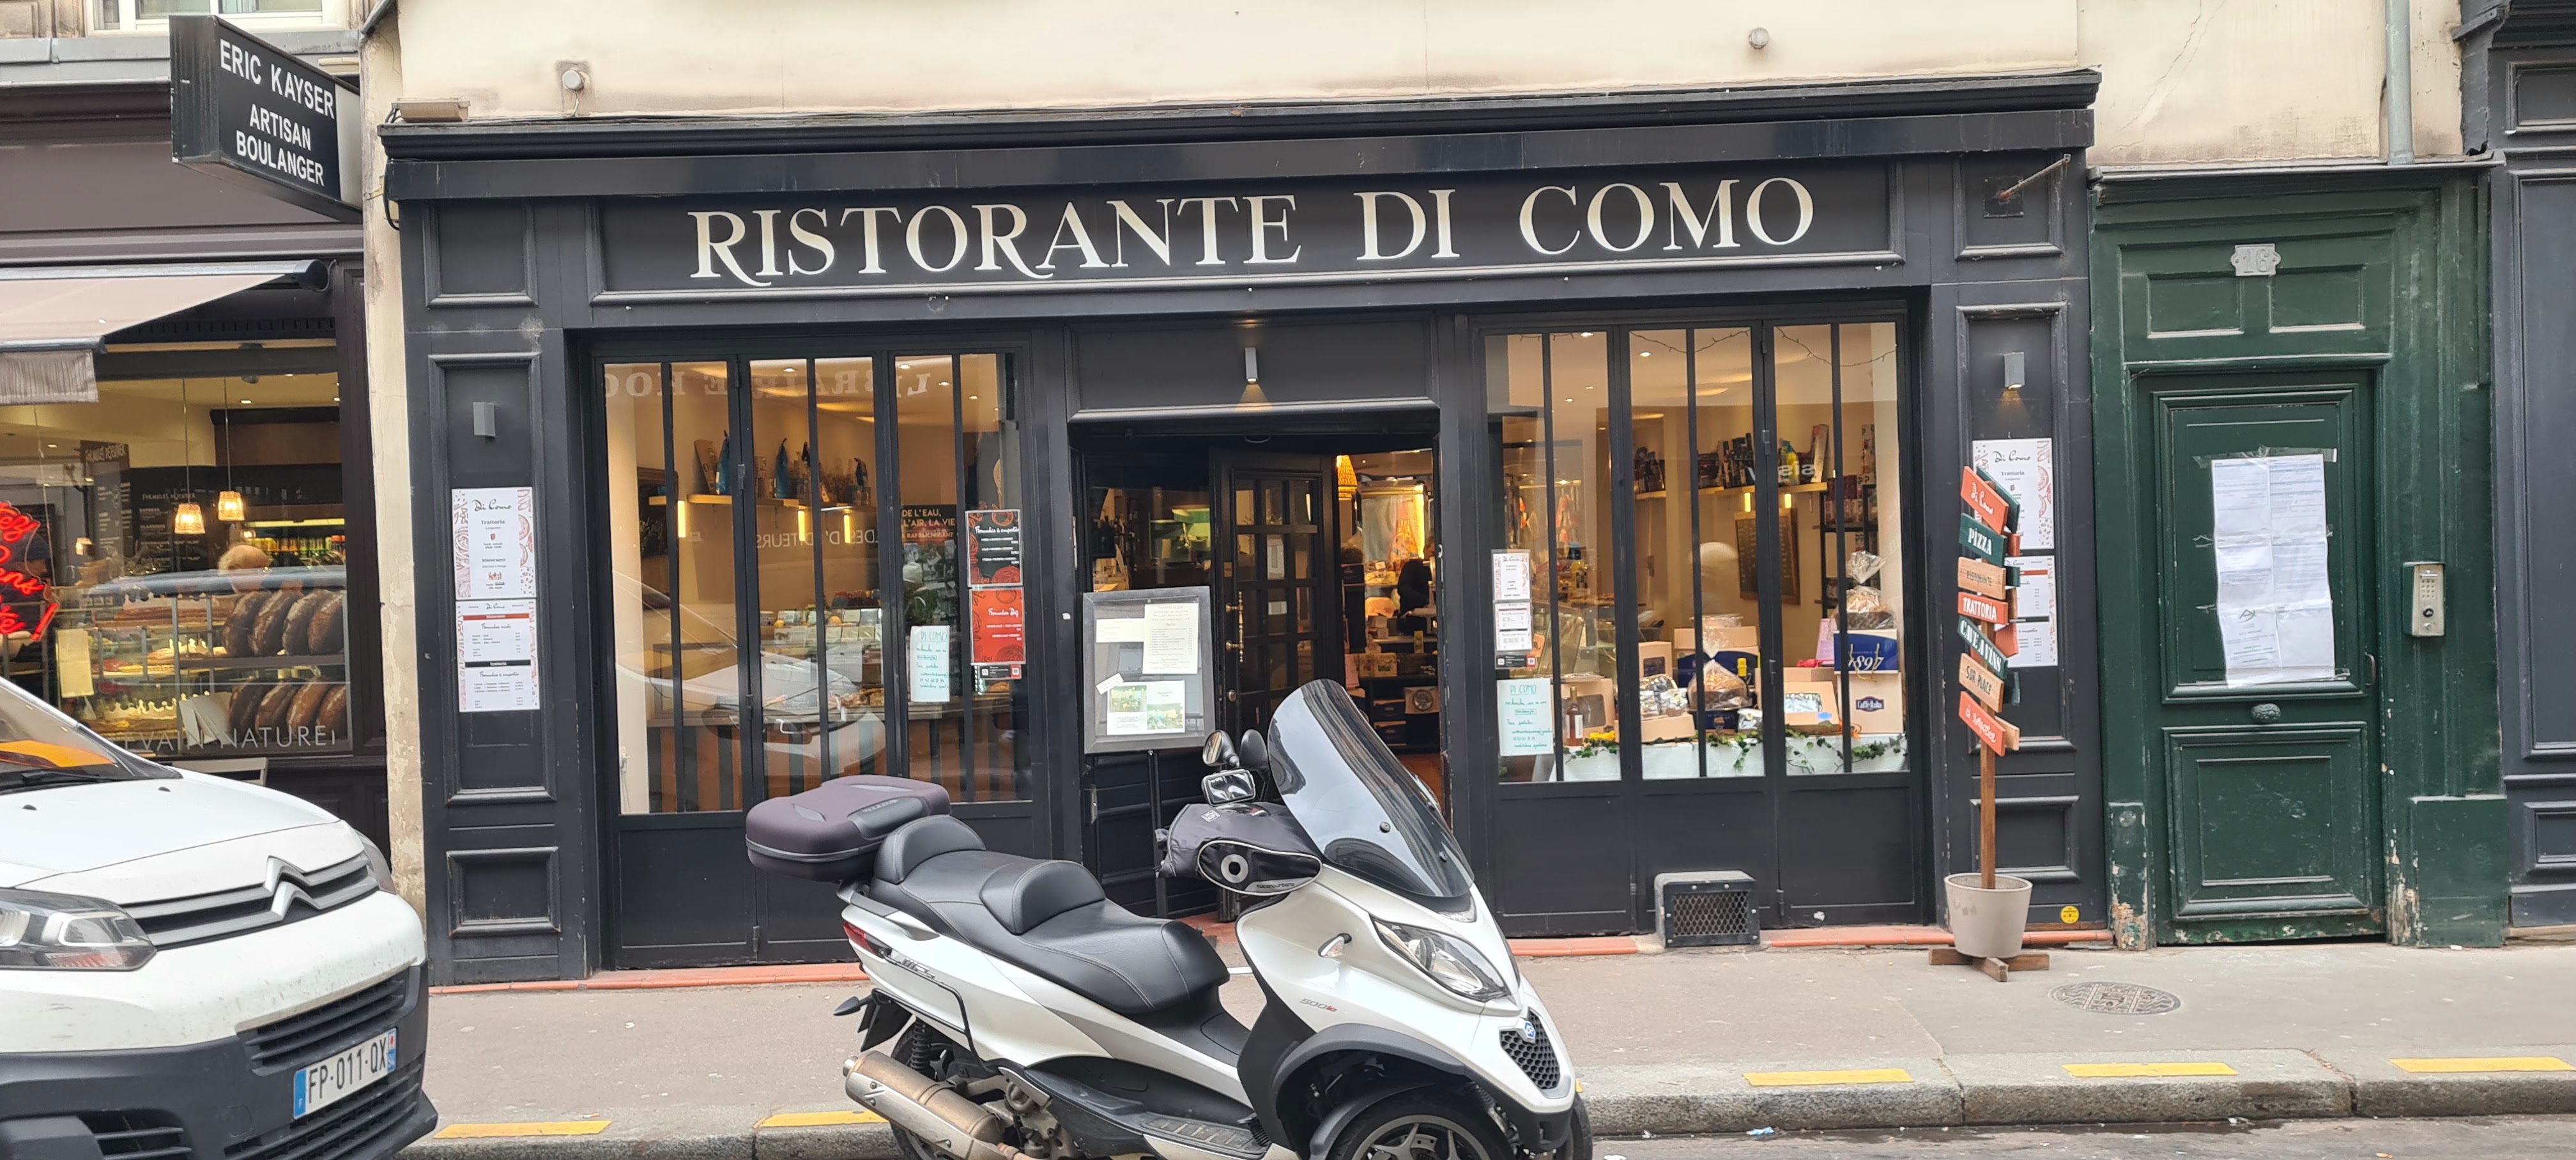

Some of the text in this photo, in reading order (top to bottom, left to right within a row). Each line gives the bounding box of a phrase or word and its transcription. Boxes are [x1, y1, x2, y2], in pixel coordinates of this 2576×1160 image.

[220, 39, 335, 119] ERIC KAYSER
[249, 103, 311, 151] ARTISAN
[236, 130, 325, 187] BOULANGER
[687, 177, 1814, 287] RISTORANTE DI COMO
[2243, 248, 2271, 273] 16
[901, 509, 913, 517] DE
[942, 518, 956, 526] VIE
[1962, 597, 1998, 622] TRATTORIA
[1960, 620, 1980, 650] CAVE
[1985, 643, 2002, 673] VINS
[1519, 684, 1537, 694] COMO
